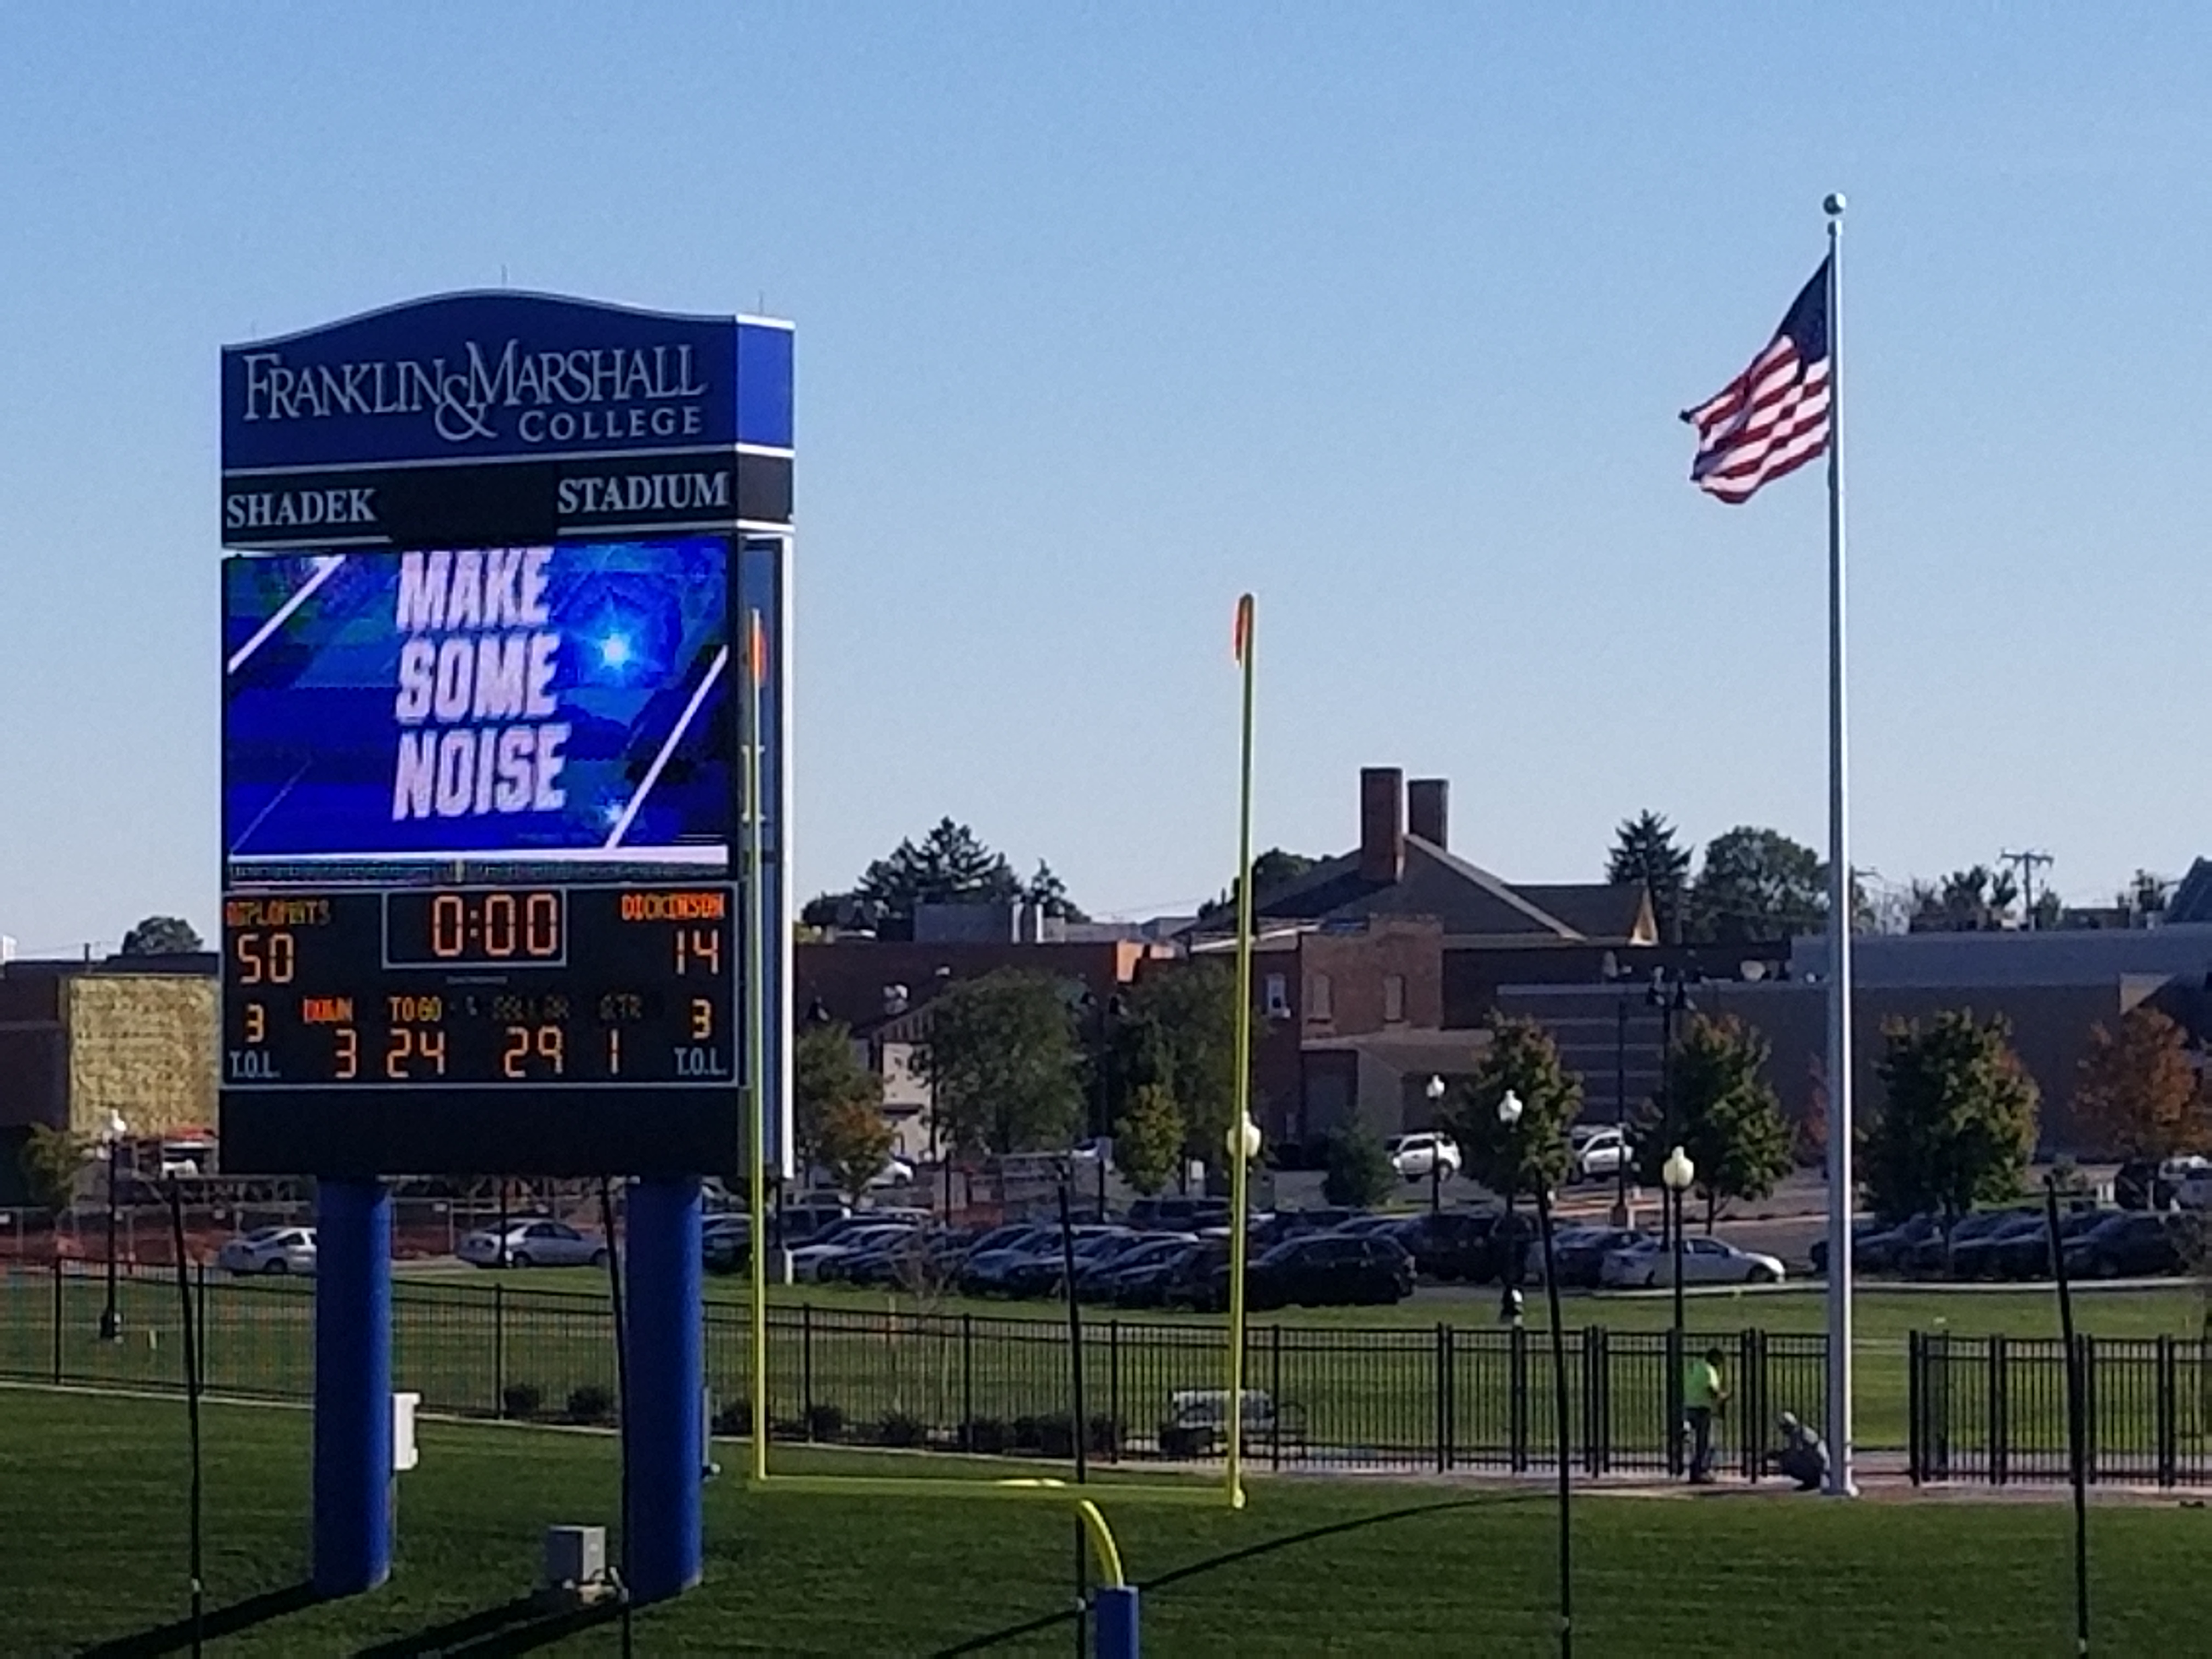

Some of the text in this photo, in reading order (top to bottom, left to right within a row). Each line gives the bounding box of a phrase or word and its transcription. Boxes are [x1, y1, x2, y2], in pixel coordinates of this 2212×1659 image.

[242, 338, 708, 441] FRANKLIN & MARSHALL
[518, 407, 702, 442] COLLEGE
[227, 472, 730, 528] SHADEK STADIUM
[397, 547, 554, 631] MAKE
[396, 633, 561, 725] SOME
[392, 722, 572, 821] NOISE
[433, 894, 557, 956] 0:00
[238, 933, 294, 983] 50
[675, 929, 719, 975] 14
[246, 1003, 264, 1042] 3
[691, 998, 712, 1040] 3
[335, 1029, 357, 1079] 3
[386, 1028, 445, 1078] 24
[504, 1025, 563, 1077] 29
[610, 1028, 619, 1074] 1
